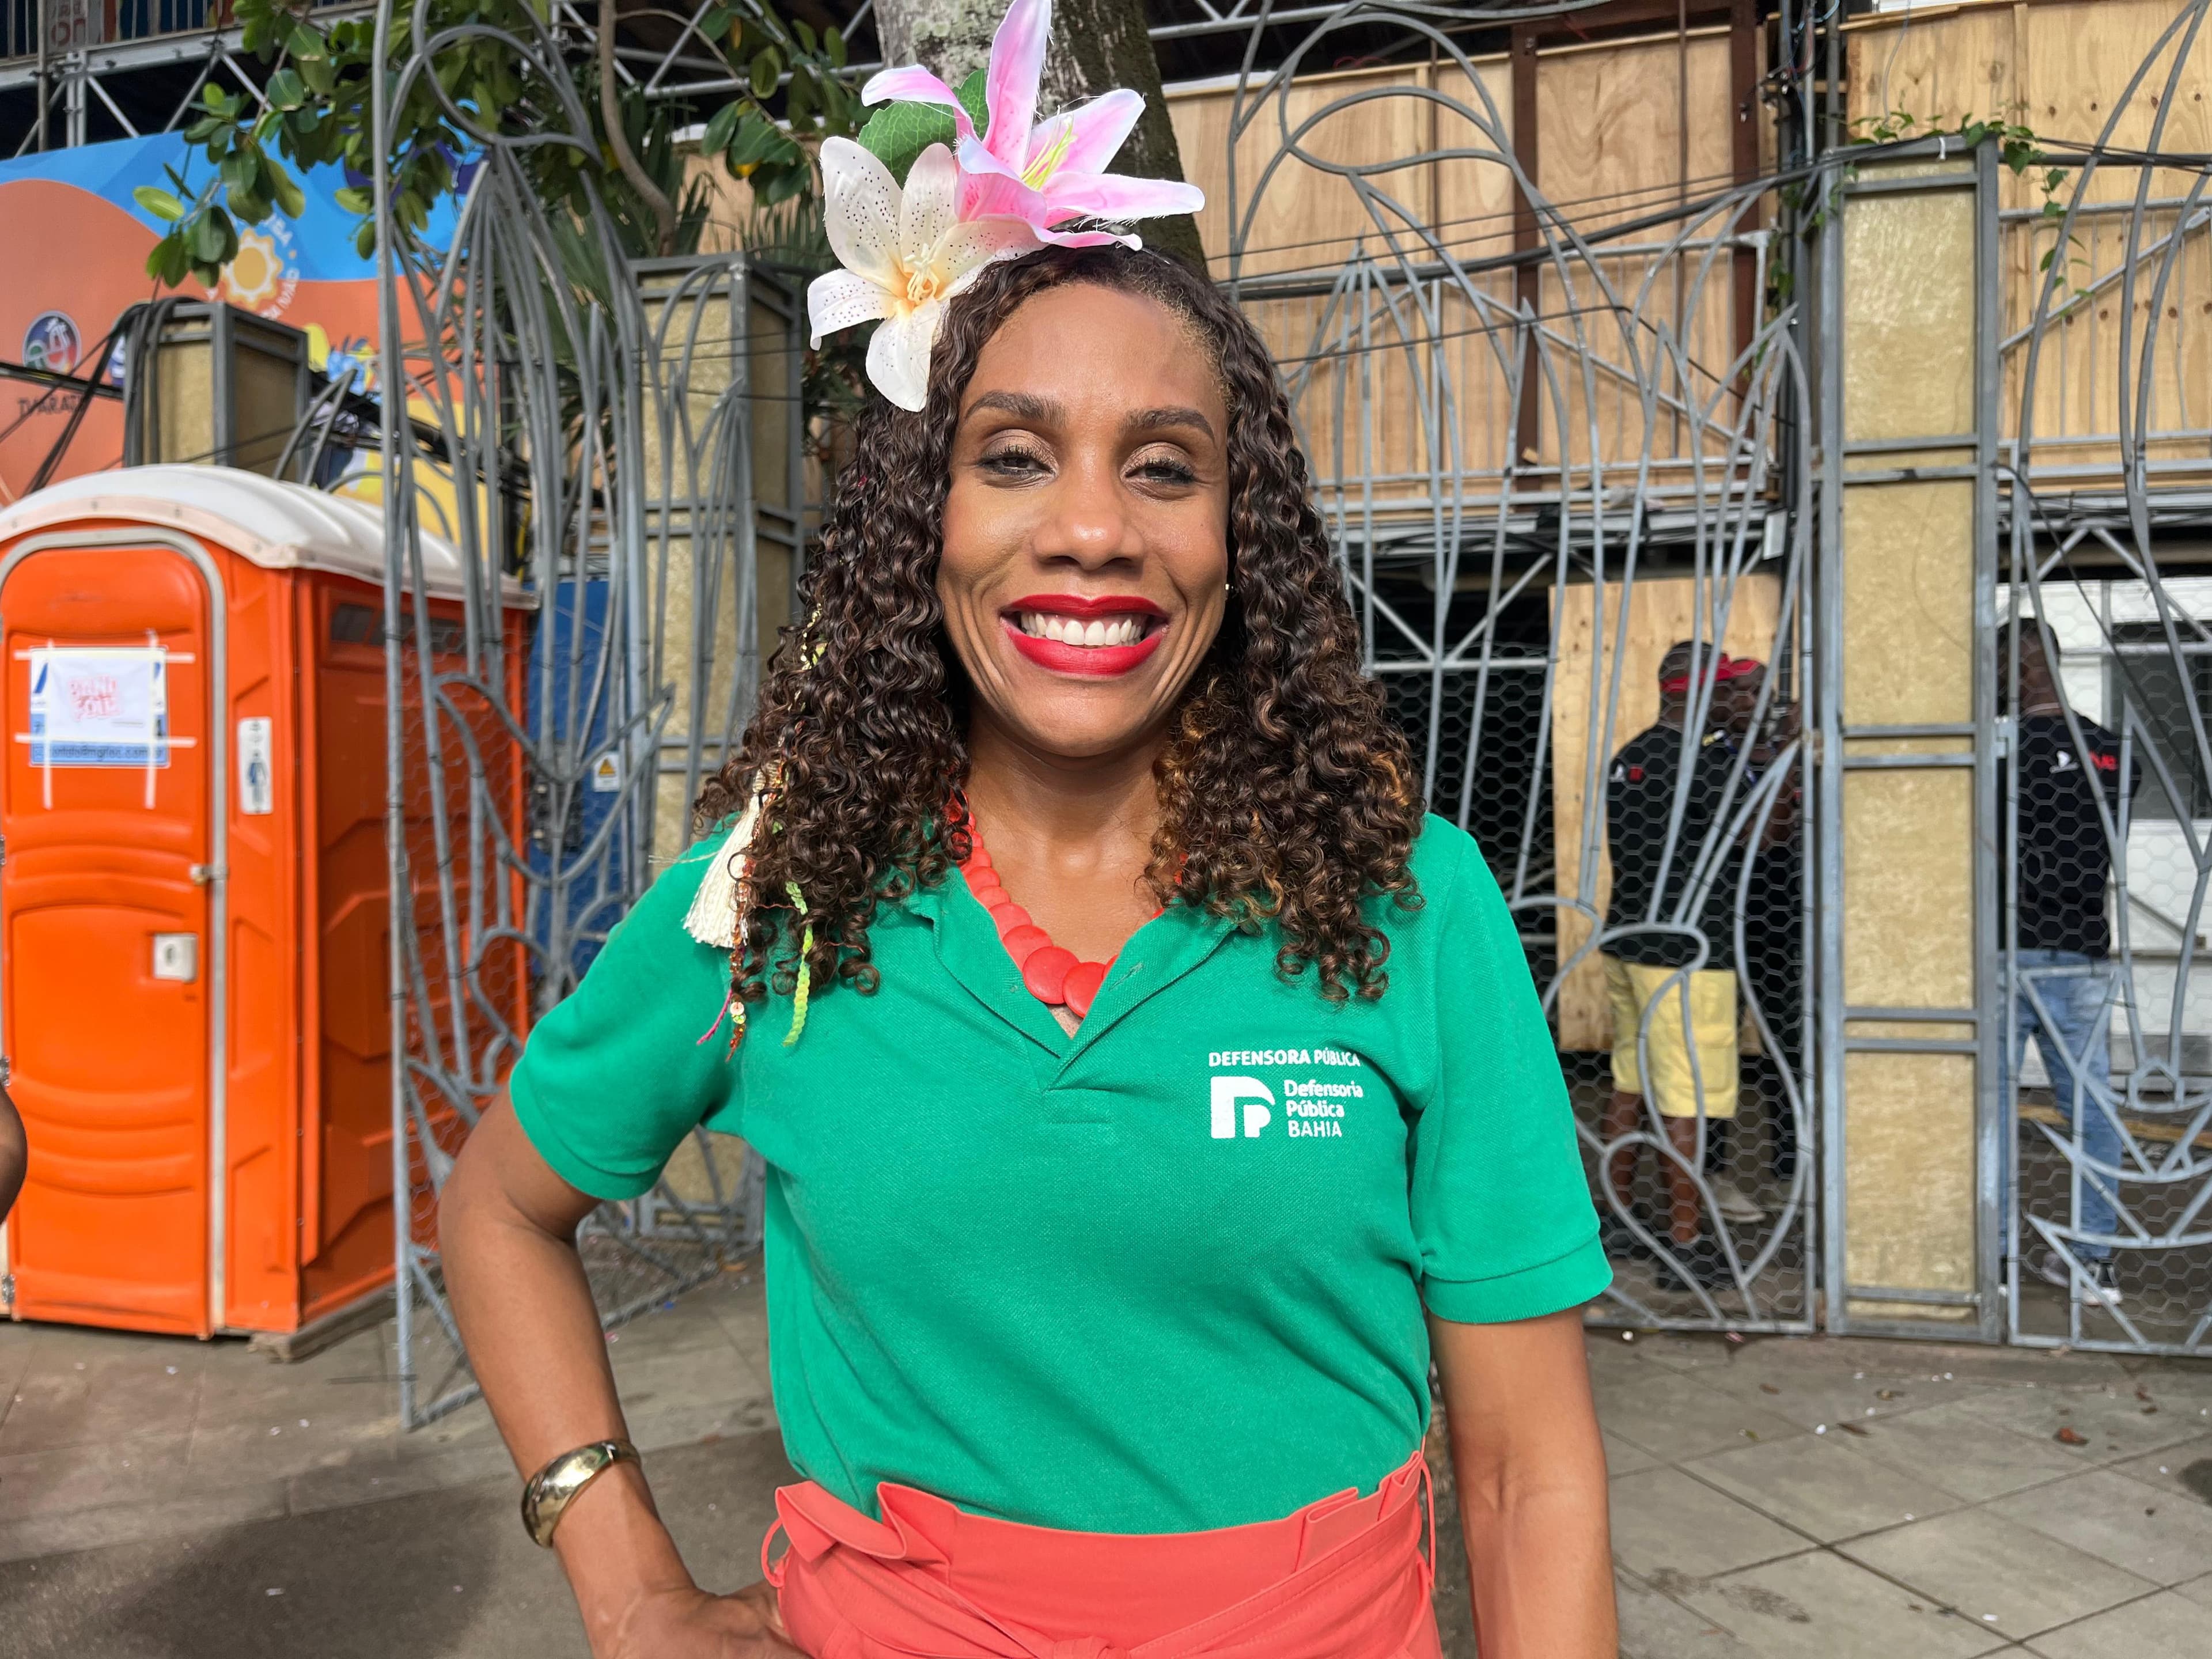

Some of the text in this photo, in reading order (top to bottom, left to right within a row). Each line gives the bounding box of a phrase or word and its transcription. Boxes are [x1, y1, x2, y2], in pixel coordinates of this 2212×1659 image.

[1209, 1047, 1361, 1067] DEFENSORA PÚBLICA
[1283, 1079, 1363, 1098] Defensoria
[1285, 1100, 1345, 1118] Pública
[1287, 1120, 1343, 1138] BAHIA
